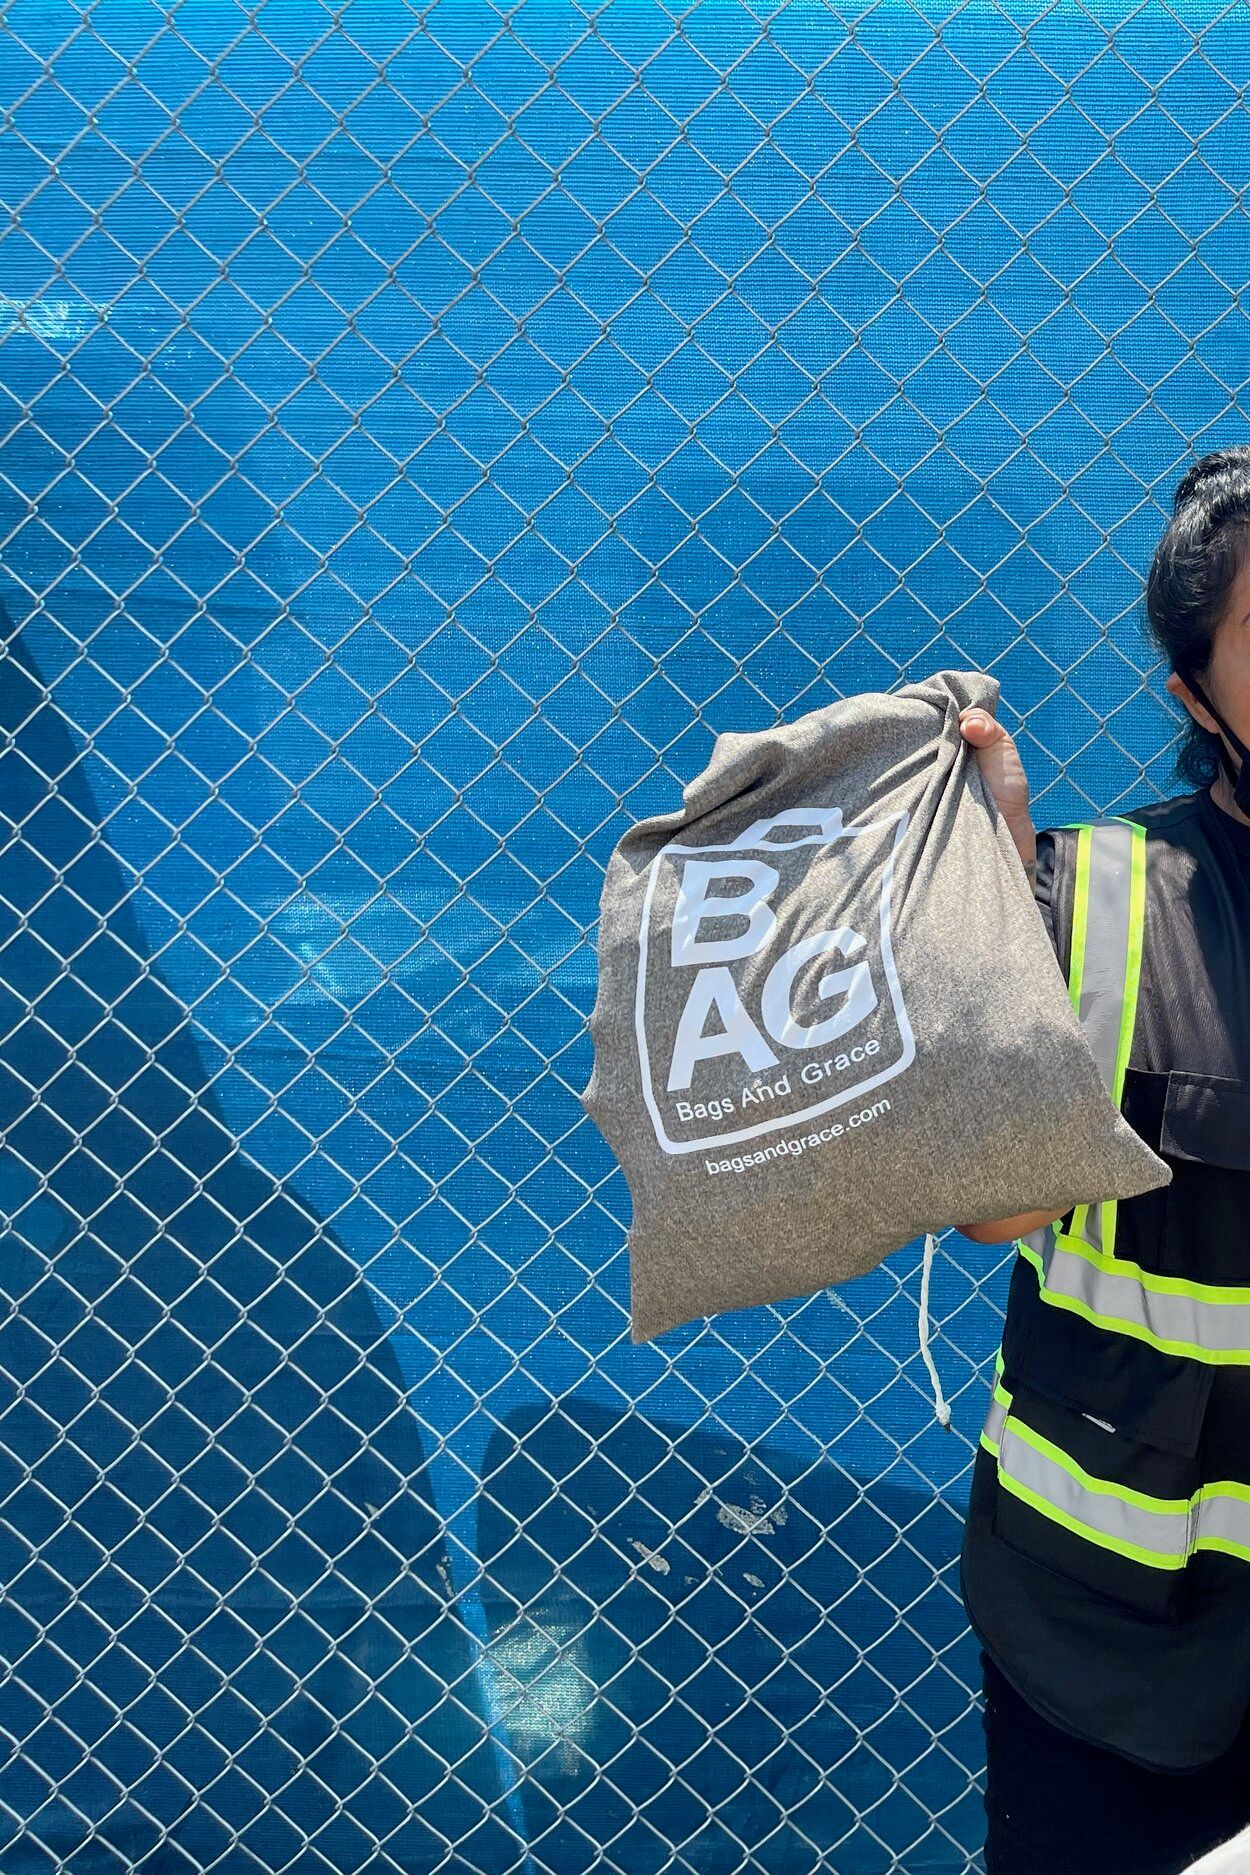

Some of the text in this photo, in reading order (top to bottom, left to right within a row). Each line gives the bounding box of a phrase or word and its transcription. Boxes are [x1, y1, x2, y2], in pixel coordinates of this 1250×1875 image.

[671, 859, 779, 967] B
[667, 926, 878, 1092] AG
[675, 1039, 881, 1122] Bags And Grace
[705, 1099, 892, 1175] bagsandgrace.com
